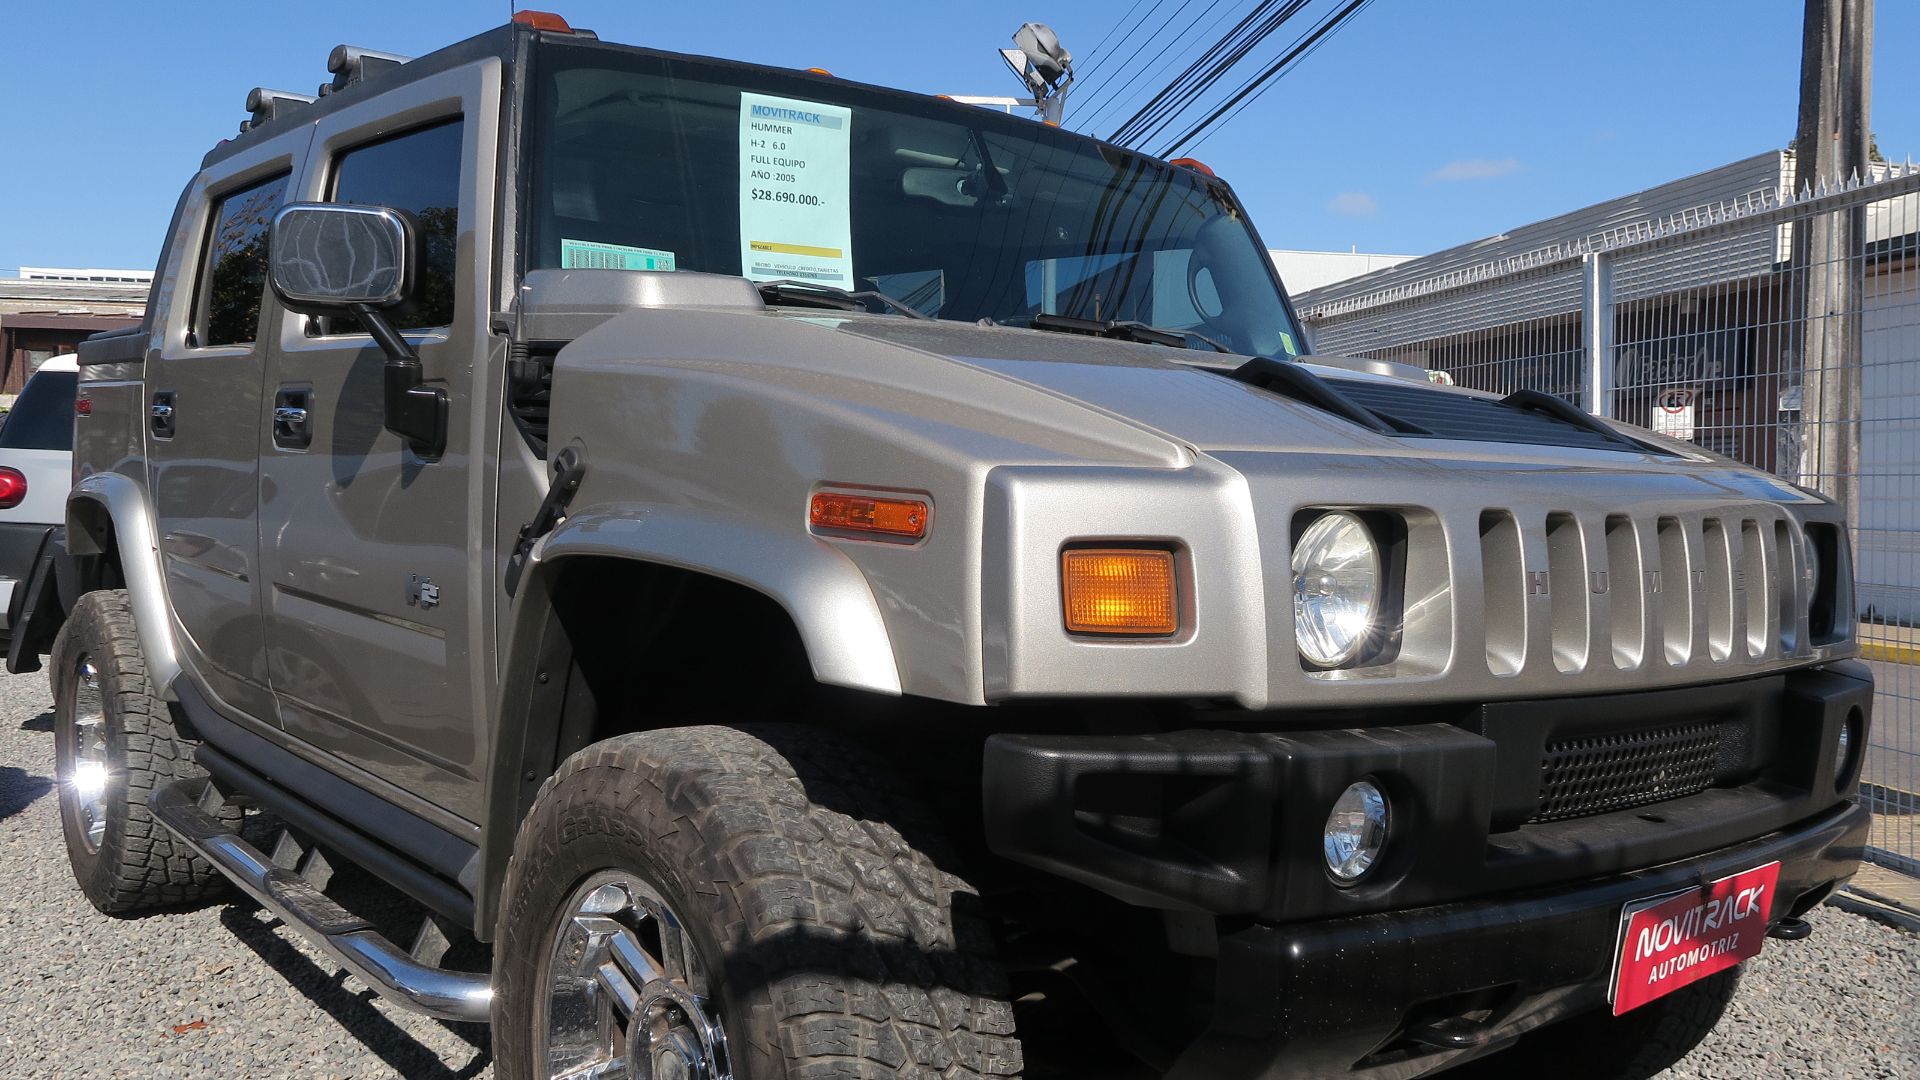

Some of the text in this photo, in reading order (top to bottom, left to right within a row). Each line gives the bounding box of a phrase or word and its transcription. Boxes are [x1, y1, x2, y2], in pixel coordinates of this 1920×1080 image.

[752, 104, 821, 124] MOVITRACK
[751, 121, 793, 135] HUMMER
[750, 138, 786, 151] H-2 6.0
[750, 154, 806, 169] FULL EQUIPO
[750, 169, 771, 180] AÑO
[751, 187, 825, 207] $28.690.000.-
[1648, 932, 1740, 985] AUTOMOTRIZ
